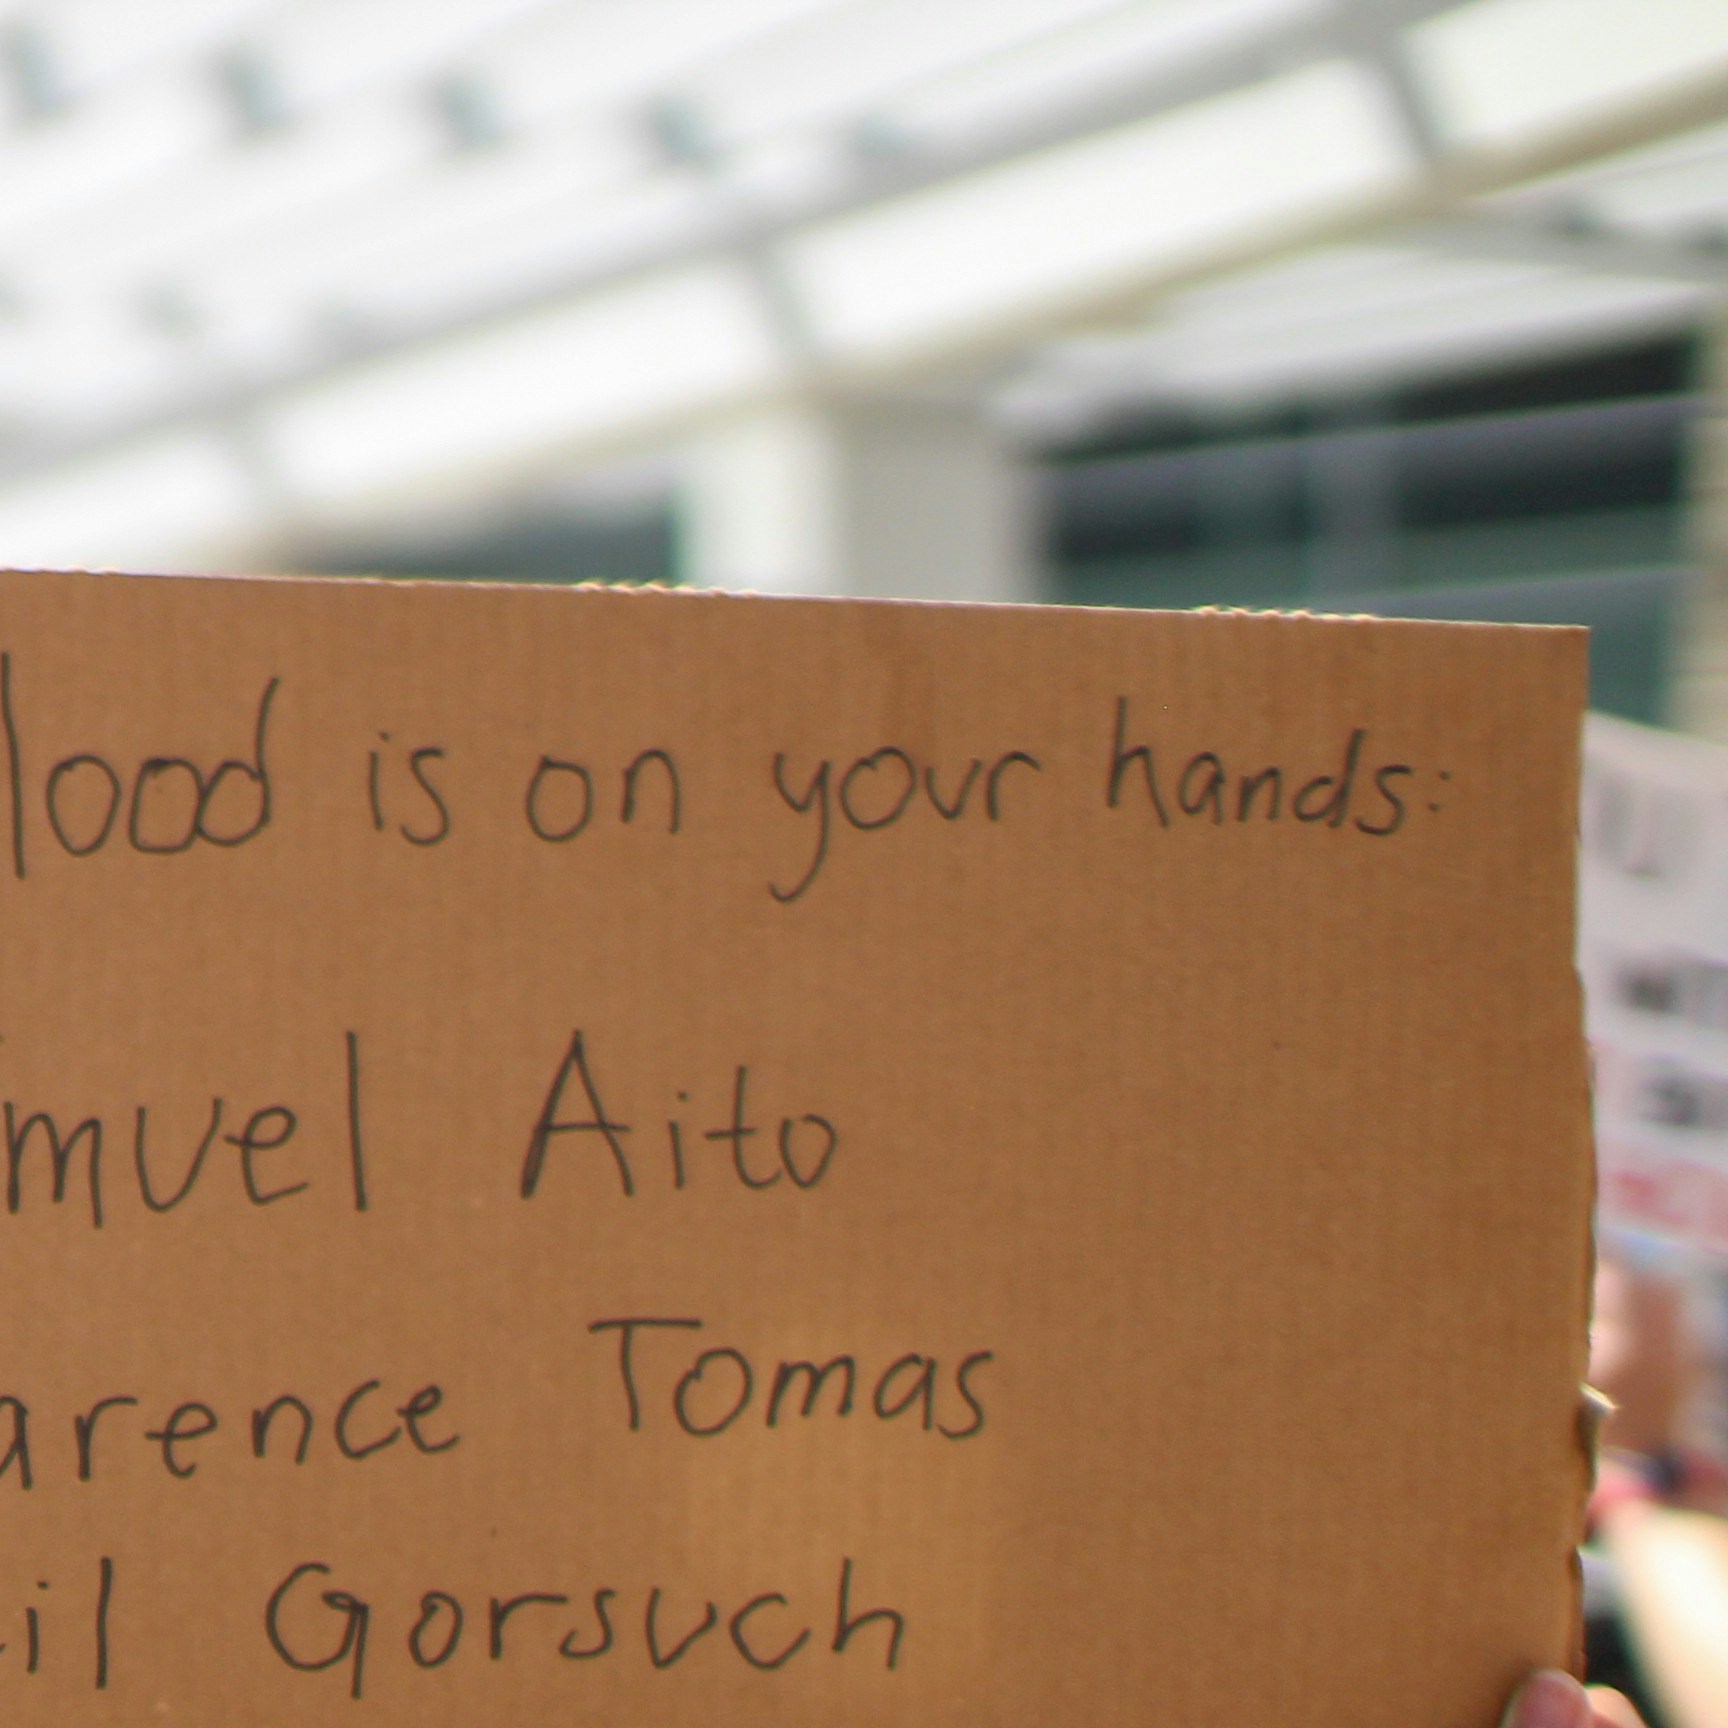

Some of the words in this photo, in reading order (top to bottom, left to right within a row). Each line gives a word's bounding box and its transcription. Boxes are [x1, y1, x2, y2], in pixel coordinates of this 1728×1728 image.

[366, 730, 452, 849] is
[523, 746, 682, 845] on
[767, 744, 1042, 905] your
[1105, 695, 1452, 838] hands:
[518, 1027, 840, 1201] Aito
[585, 1315, 995, 1442] Tomas
[263, 1556, 907, 1702] Gorsuch
